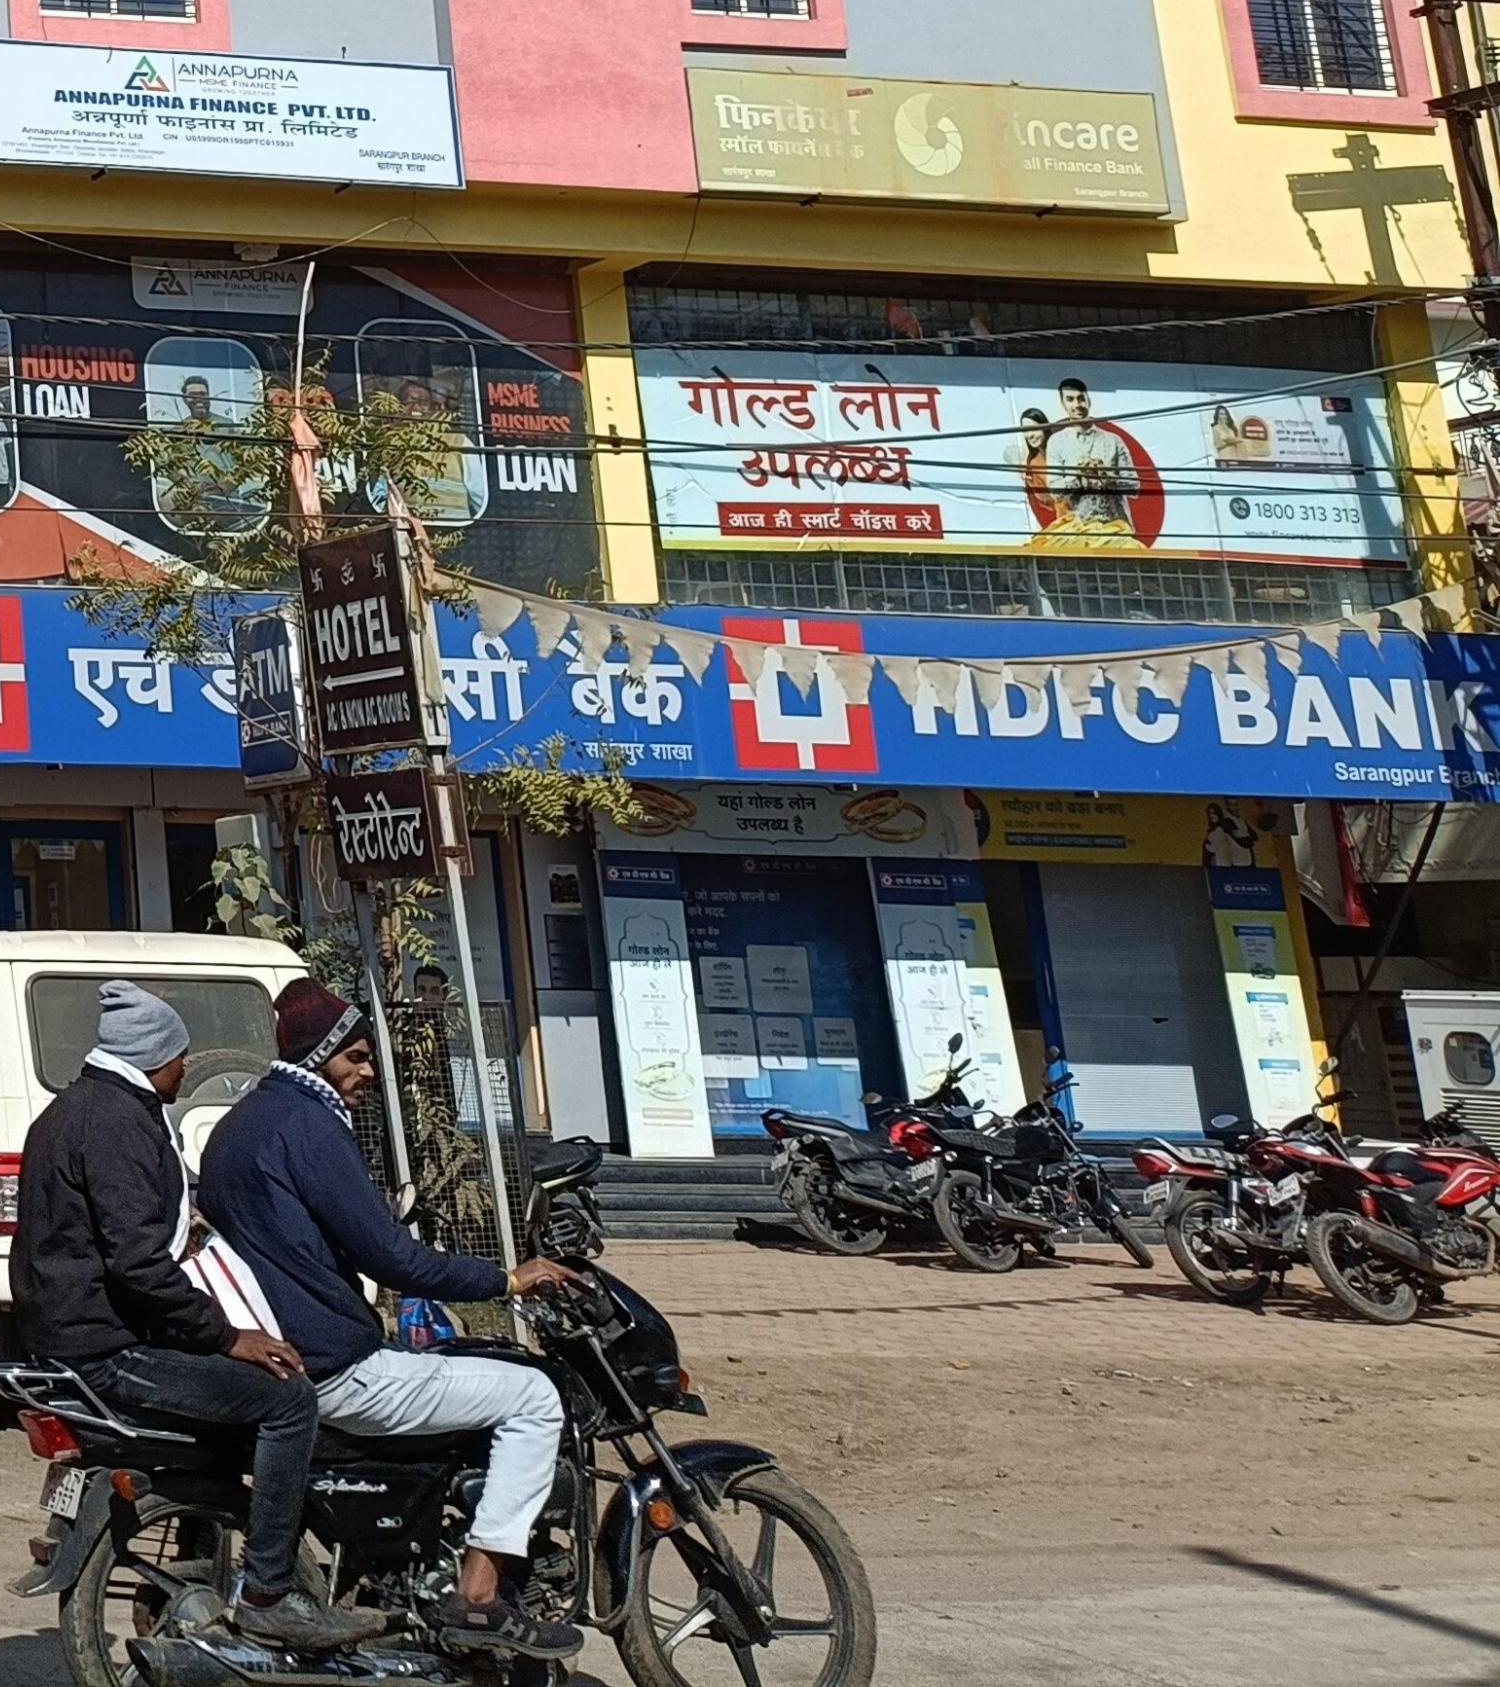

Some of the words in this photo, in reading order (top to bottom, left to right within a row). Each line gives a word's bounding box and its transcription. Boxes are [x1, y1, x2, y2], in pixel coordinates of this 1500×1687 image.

[178, 63, 299, 82] ANNAPURNA
[233, 80, 277, 90] FINANCE
[54, 90, 185, 110] ANNAPURNA
[190, 97, 278, 115] FINANCE
[288, 103, 332, 120] PVT.
[336, 106, 377, 123] LTD.
[72, 108, 149, 129] अन्नपूर्णा
[281, 118, 359, 140] लिमिटेड
[72, 129, 107, 138] Finance
[1013, 112, 1140, 153] incare
[359, 148, 410, 161] SARANGPUR
[411, 152, 445, 163] BRANCH
[1045, 160, 1101, 174] Finance
[1106, 163, 1144, 176] Bank
[194, 265, 298, 284] ANNAPURNA
[224, 282, 270, 293] FINANCE
[20, 343, 136, 383] HOUSING
[22, 383, 91, 419] LOAN
[488, 382, 540, 409] MSME
[678, 366, 816, 430] गोल्ड
[829, 363, 941, 432] लोन
[491, 413, 572, 441] BUSINESS
[496, 445, 578, 494] LOAN
[736, 444, 912, 491] उपलब्ध
[728, 512, 765, 528] आज
[774, 510, 792, 529] ही
[801, 510, 841, 530] स्मार्ट
[851, 510, 897, 531] चॉइस
[1255, 502, 1294, 520] 1800
[1299, 505, 1328, 522] 313
[1332, 507, 1361, 524] 313
[313, 596, 400, 665] HOTEL
[239, 643, 290, 704] ATM
[68, 647, 173, 729] एच
[376, 690, 411, 725] ROOMS
[912, 662, 1181, 744] HDFC
[1212, 670, 1500, 752] BANK
[652, 741, 693, 761] शाखा
[1334, 760, 1435, 786] Sarangpur
[1439, 764, 1500, 786] Branc
[750, 792, 784, 810] गोल्ड
[788, 794, 817, 811] लोन
[736, 816, 789, 834] उपलब्ध
[793, 815, 805, 835] है
